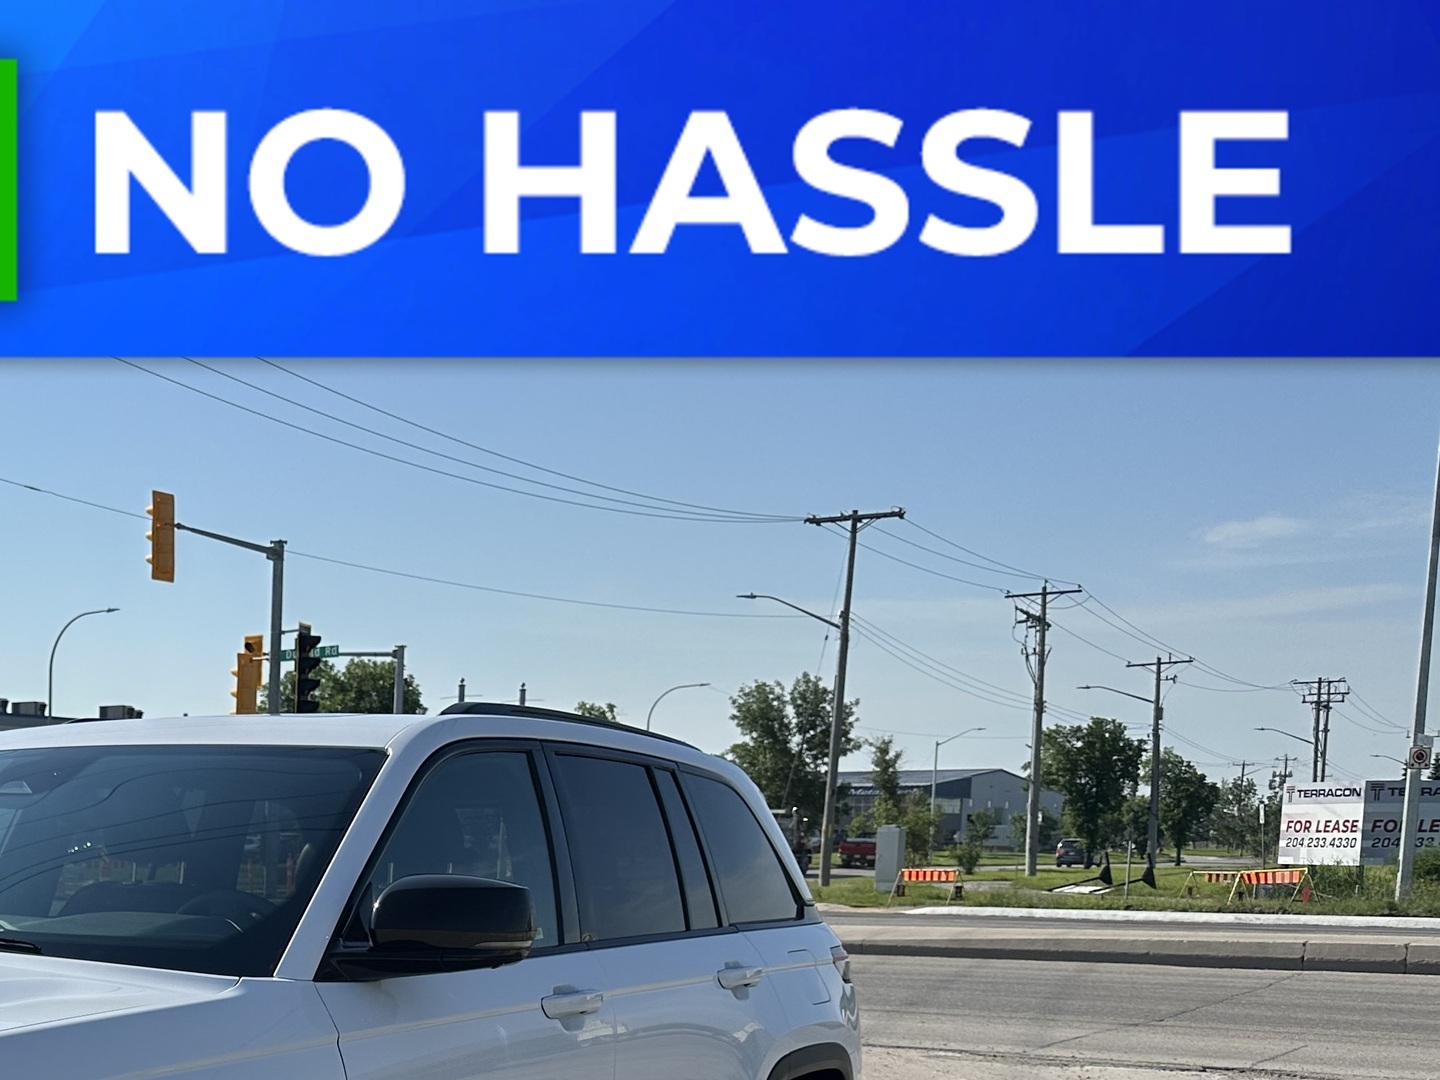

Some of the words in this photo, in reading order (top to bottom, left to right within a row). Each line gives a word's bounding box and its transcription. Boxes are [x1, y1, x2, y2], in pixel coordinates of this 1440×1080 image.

[325, 646, 337, 656] Rd
[1297, 787, 1362, 799] TERRACON
[1286, 820, 1311, 833] FOR
[1315, 819, 1359, 833] LEASE
[1285, 837, 1357, 848] 204.233.4330
